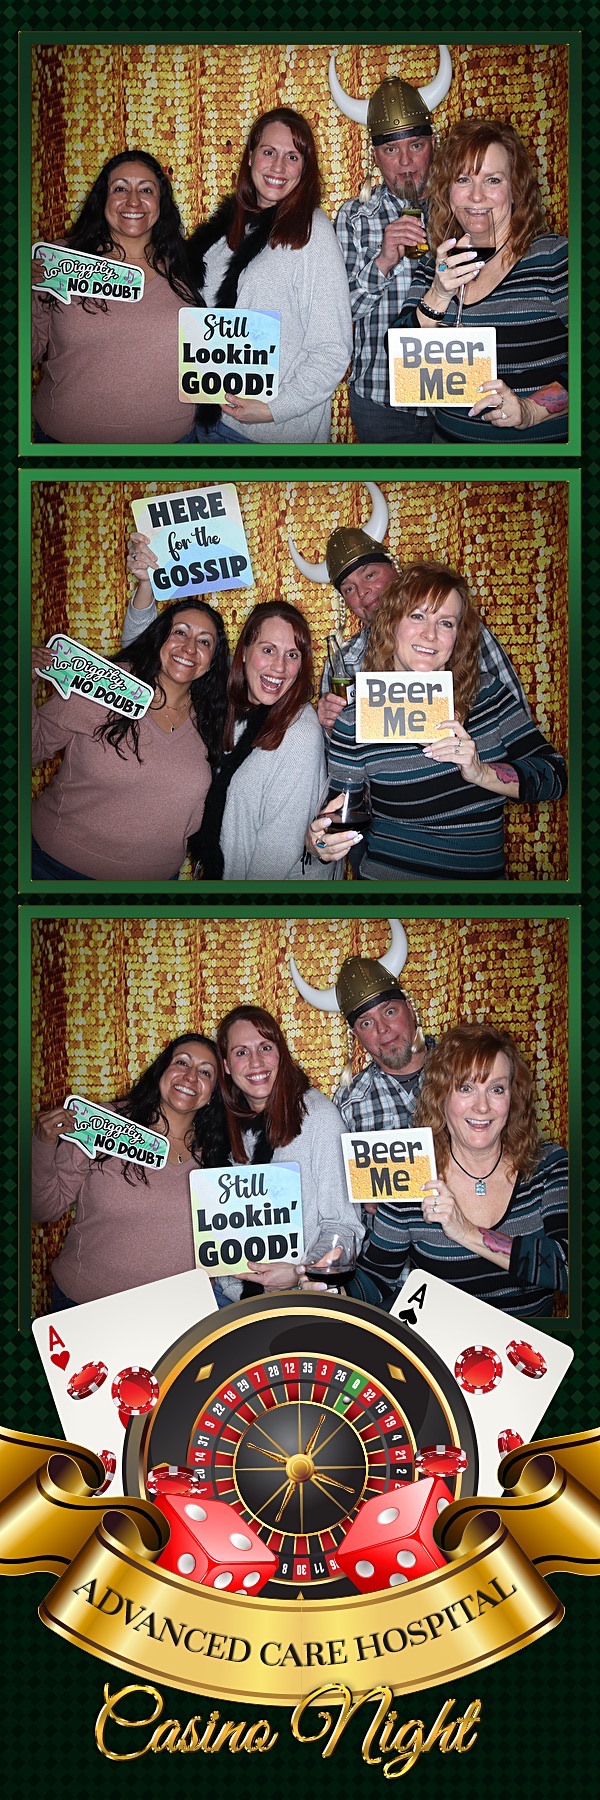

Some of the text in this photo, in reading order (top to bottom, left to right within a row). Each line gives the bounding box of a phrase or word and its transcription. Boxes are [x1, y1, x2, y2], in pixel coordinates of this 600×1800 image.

[58, 259, 119, 281] Diggity,
[67, 278, 141, 300] NO DOUBT
[203, 313, 249, 341] Still
[183, 343, 276, 365] Lookin'
[400, 336, 484, 368] Beer
[182, 371, 275, 396] GOOD!
[419, 367, 466, 401] Me
[147, 491, 226, 528] HERE
[168, 526, 220, 561] for the
[153, 555, 248, 590] GOSSIP
[71, 657, 127, 691] Diggity,
[70, 675, 145, 718] NO DOUBT
[366, 679, 443, 708] Beer
[383, 706, 427, 737] Me
[89, 1115, 145, 1144] Diggity,
[94, 1134, 165, 1167] NO DOUBT
[351, 1140, 423, 1168] Beer
[218, 1173, 268, 1204] Still
[370, 1167, 410, 1197] Me
[197, 1201, 298, 1232] Lookin'
[198, 1233, 299, 1267] GOOD!
